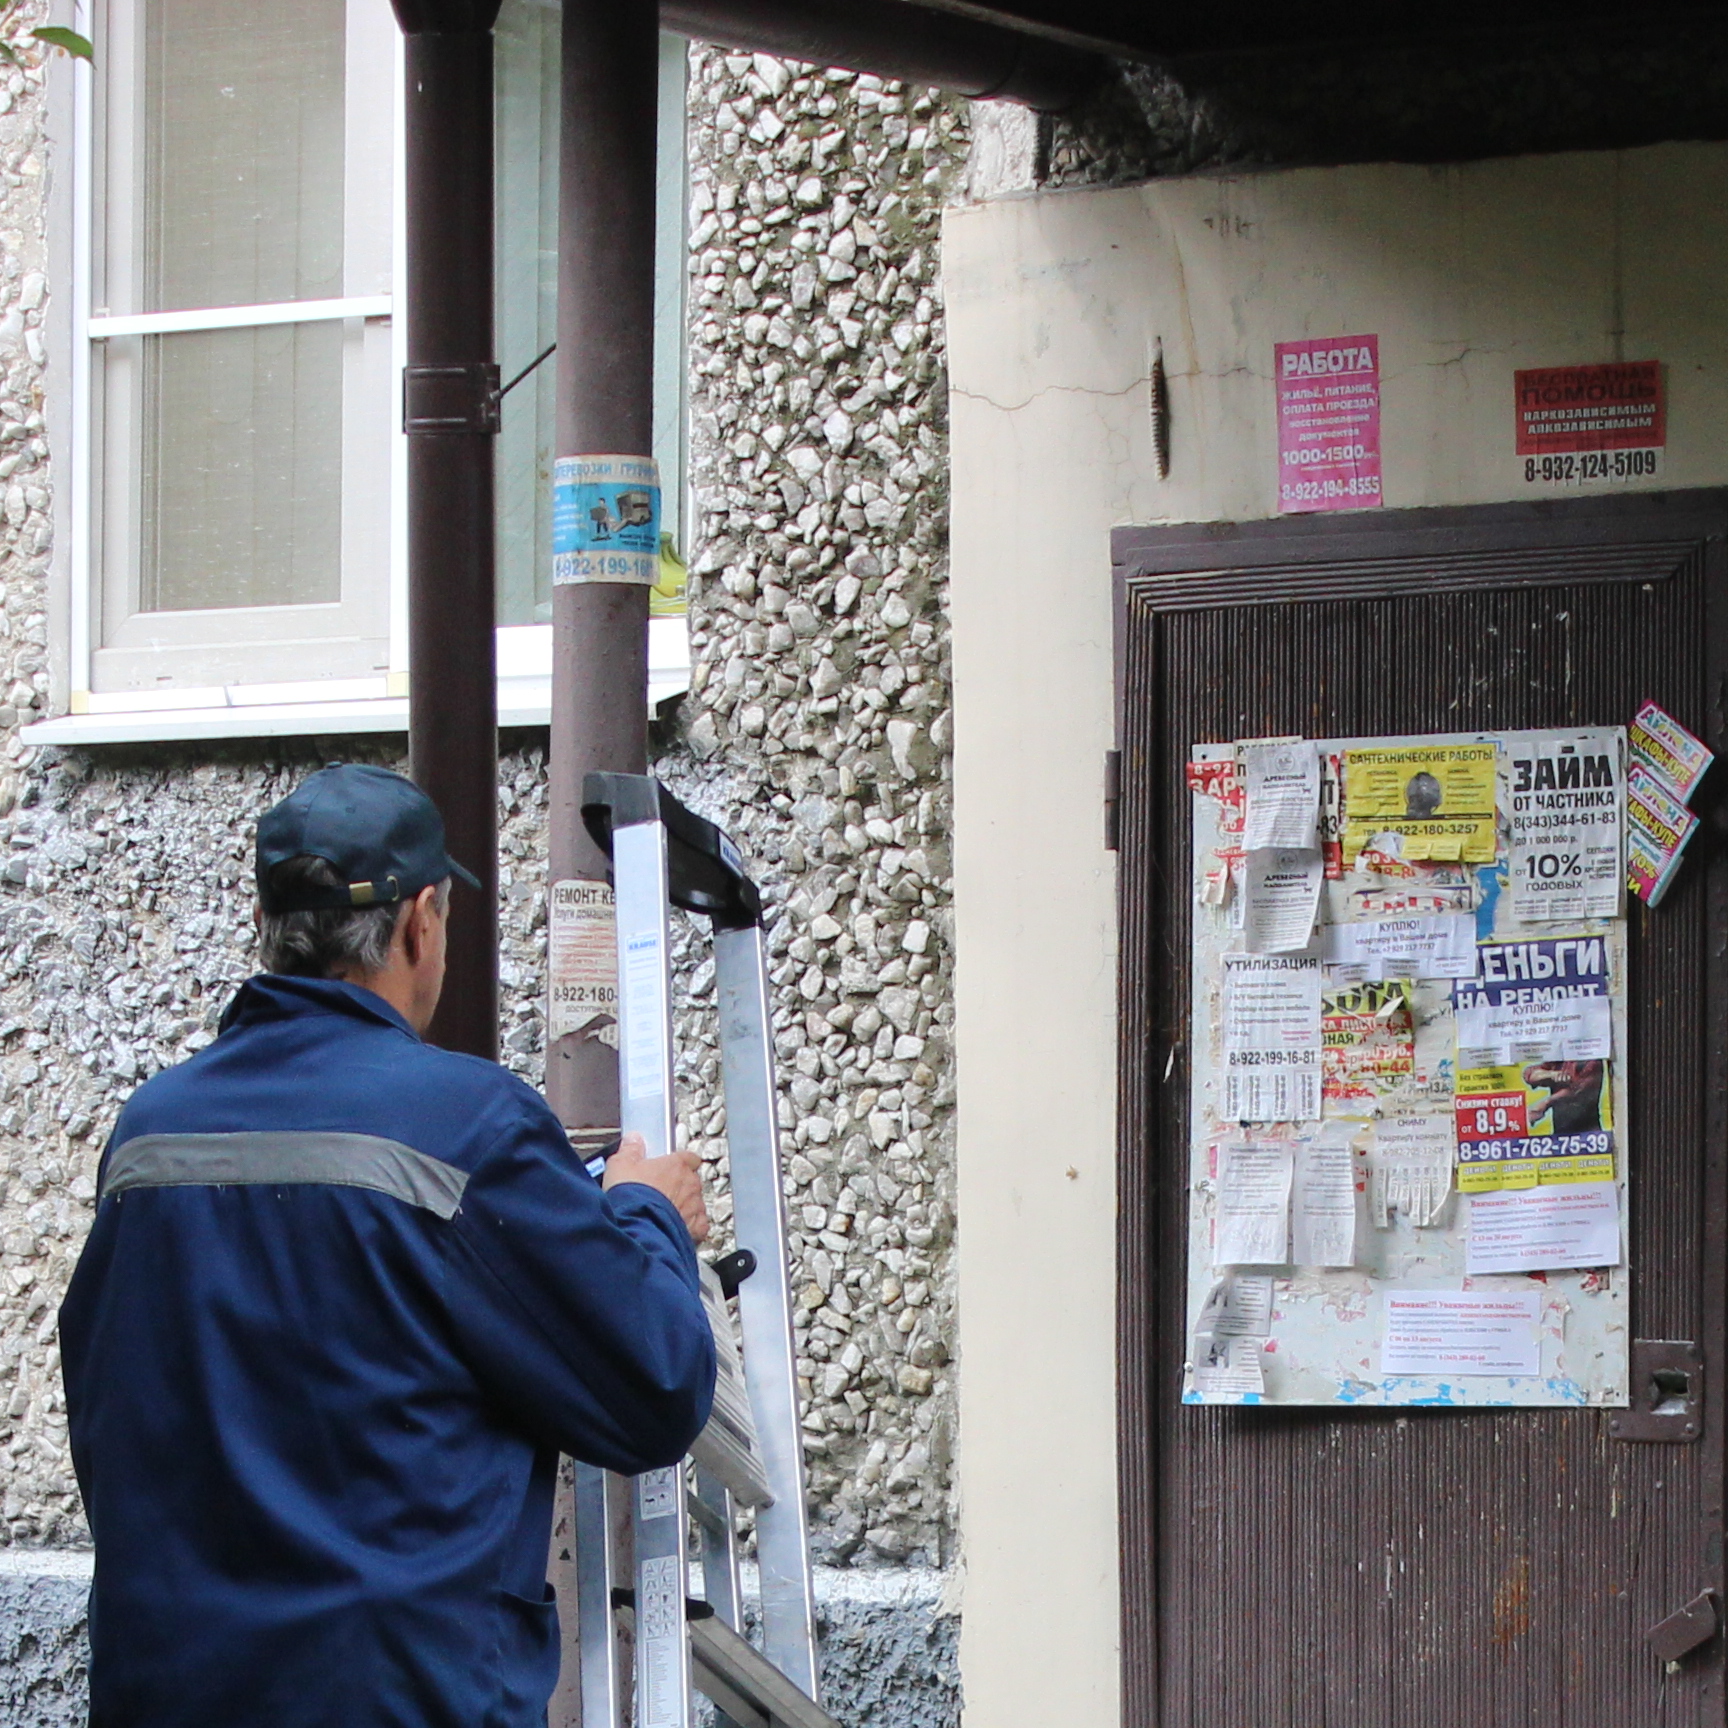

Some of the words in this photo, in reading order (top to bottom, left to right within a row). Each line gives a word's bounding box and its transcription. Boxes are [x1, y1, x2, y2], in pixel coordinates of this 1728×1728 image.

[1282, 347, 1373, 376] РАБОТА
[1282, 402, 1324, 416] ОПЛАТА
[1524, 403, 1656, 422] НАРКОЗАВИСИМЫМ
[1527, 417, 1652, 435] АЛКОЗАВИСИМЫМ
[1525, 450, 1656, 482] 8-932-124-5109
[1282, 476, 1381, 501] 8-922-194-8555
[1349, 750, 1446, 765] САНТЕХНИЧЕСКИЕ
[1448, 749, 1493, 761] РАБОТЫ
[1513, 746, 1613, 792] ЗАЙМ
[1514, 796, 1531, 811] ОТ
[1536, 791, 1615, 809] ЧАСТНИКА
[1382, 823, 1479, 836] 8-922-180-3257
[1514, 812, 1616, 831] 8(343)344-61-83
[1529, 837, 1533, 845] 1
[1536, 836, 1551, 845] 000
[1525, 853, 1582, 879] 10%
[554, 887, 598, 904] РЕМОНТ
[1379, 920, 1420, 932] КУПЛЮ!
[1355, 935, 1390, 948] квартиру
[1400, 933, 1426, 942] Вашем
[1225, 957, 1317, 971] УТИЛИЗАЦИЯ
[1457, 991, 1491, 1010] НА
[1500, 983, 1599, 1007] РЕМОНТ
[1512, 1002, 1555, 1016] КУПЛЮ!
[1488, 1018, 1524, 1030] квартиру
[1532, 1015, 1559, 1025] Вашем
[1560, 1013, 1582, 1023] доме
[1229, 1050, 1315, 1065] 8-922-199-16-81
[1456, 1098, 1488, 1110] Снизим
[1491, 1094, 1523, 1108] ставку!
[1397, 1118, 1427, 1127] СНИМУ
[1460, 1133, 1608, 1160] 8-961-762-75-39
[1502, 1163, 1535, 1173] ДЕНЬГИ
[1539, 1161, 1571, 1170] ДЕНЬГИ
[1578, 1158, 1610, 1168] ДЕНЬГИ
